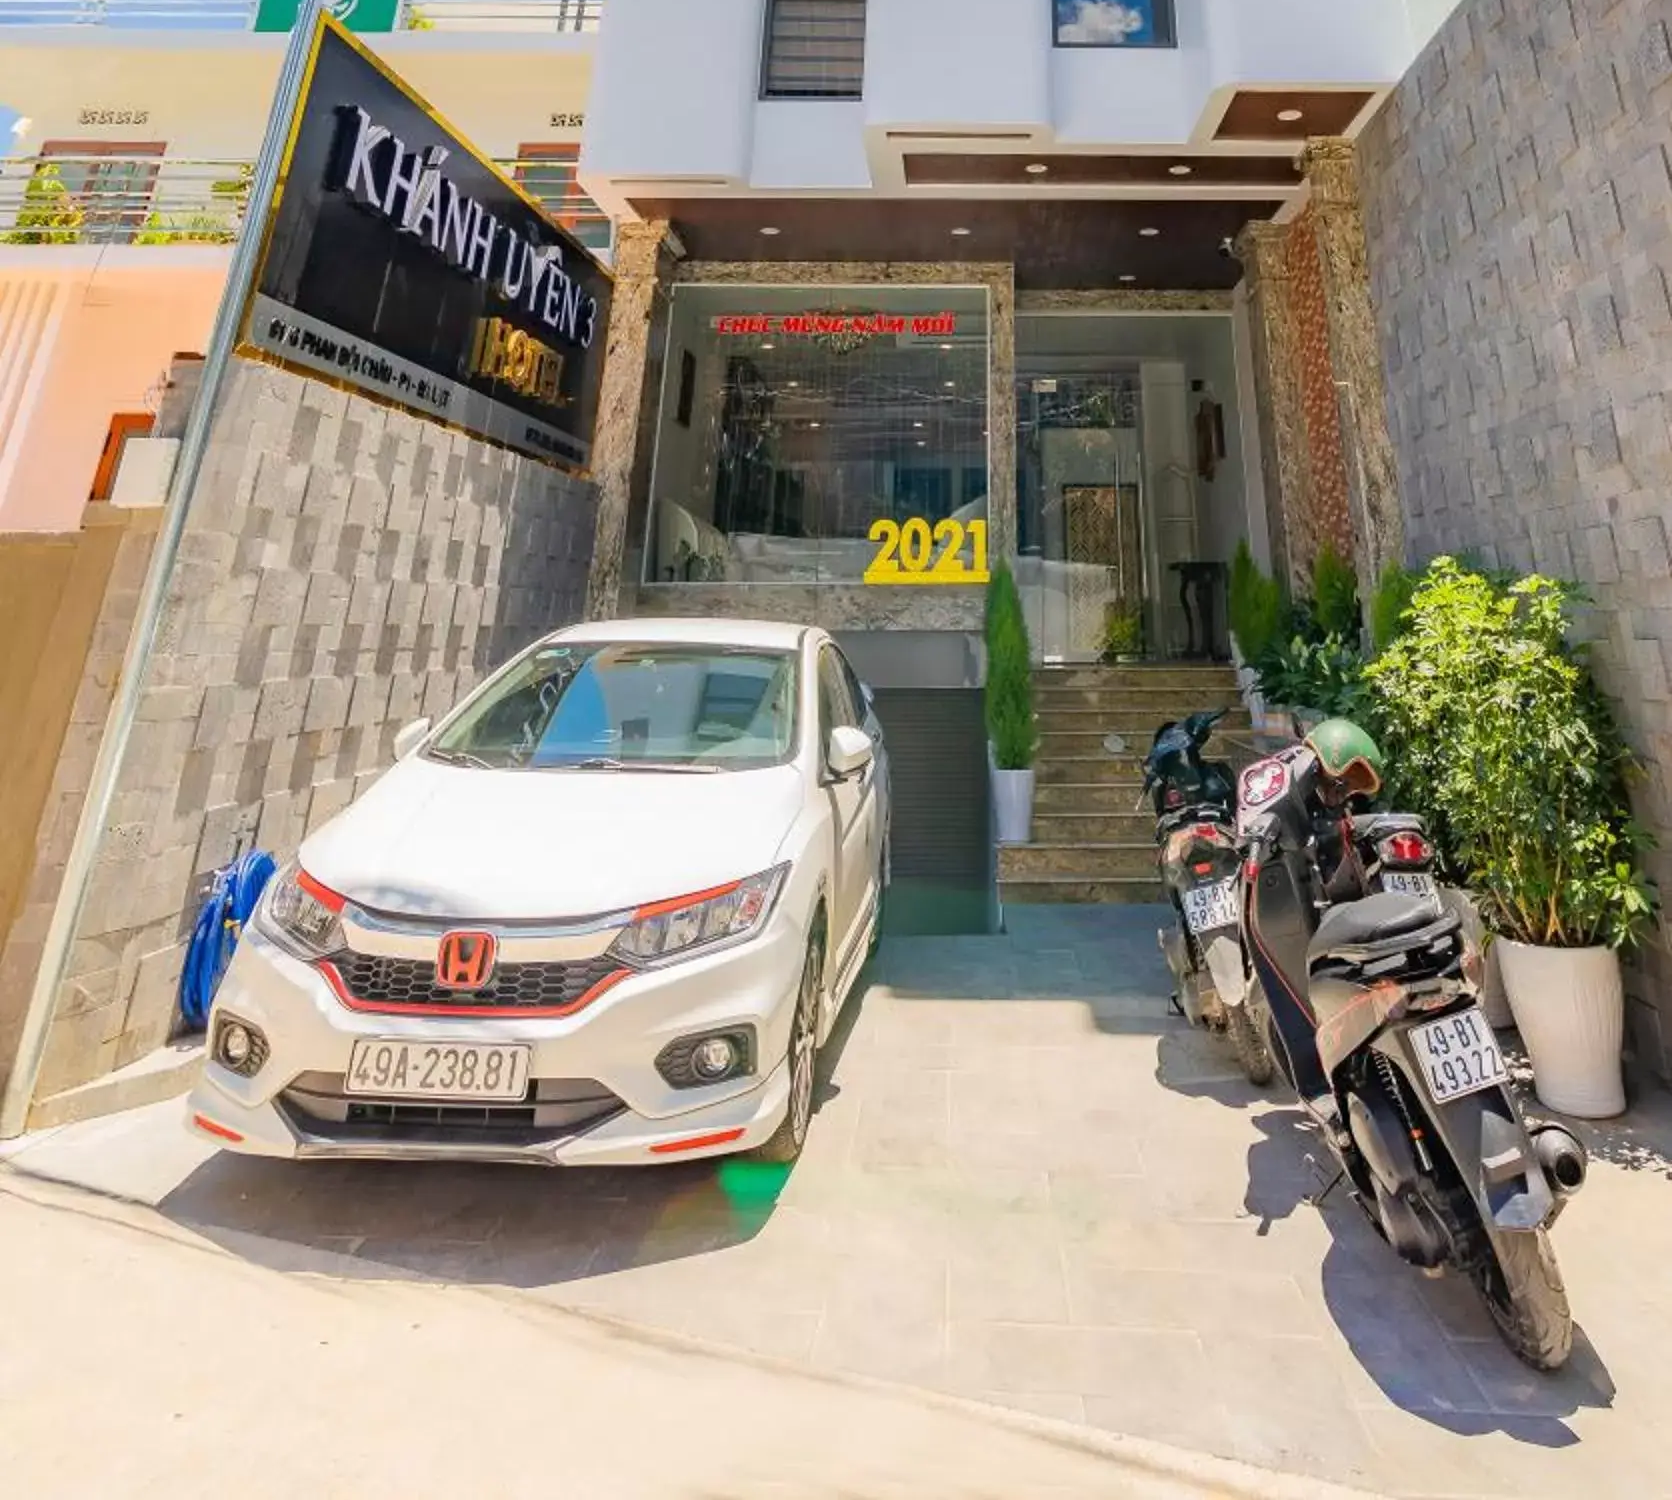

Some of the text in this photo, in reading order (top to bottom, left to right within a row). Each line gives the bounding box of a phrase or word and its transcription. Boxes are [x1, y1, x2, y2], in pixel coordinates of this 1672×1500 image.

[345, 106, 597, 349] KHÁNH UYÊN 3
[867, 516, 988, 577] 2021
[1425, 1014, 1481, 1057] 49-B1
[354, 1044, 519, 1091] 49A-238.81
[1431, 1045, 1504, 1094] 493.22
